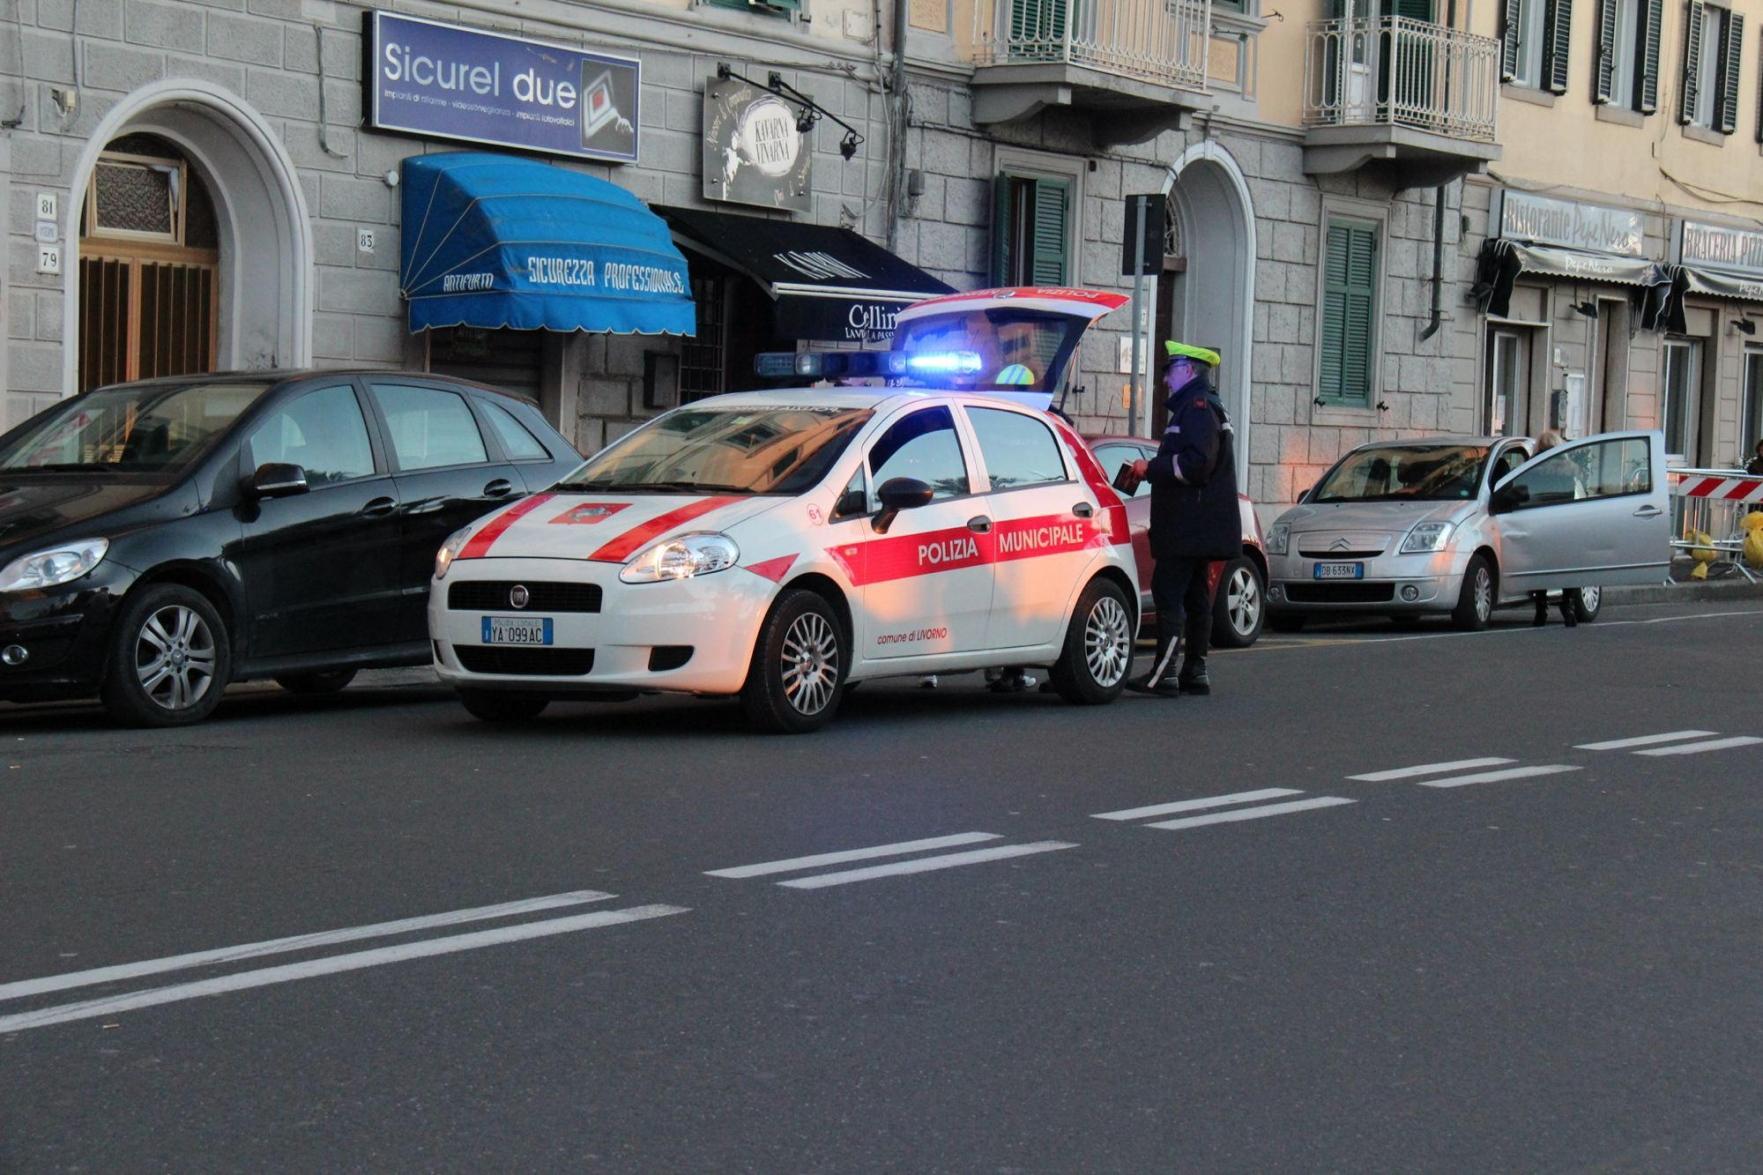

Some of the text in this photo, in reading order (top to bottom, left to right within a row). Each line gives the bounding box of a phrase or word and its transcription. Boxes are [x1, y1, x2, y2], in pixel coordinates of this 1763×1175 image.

[384, 42, 577, 108] Sicurel due
[42, 199, 53, 214] 81
[361, 234, 373, 248] 83
[43, 252, 57, 267] 79
[443, 273, 494, 292] ANTIFURTO
[528, 256, 685, 294] SICUREZZA PROFESSIONALE
[848, 304, 902, 330] Cellin
[918, 523, 1083, 566] POLIZIA MUNICIPALE
[492, 626, 504, 642] YA
[877, 627, 948, 645] comune di LIVORNO
